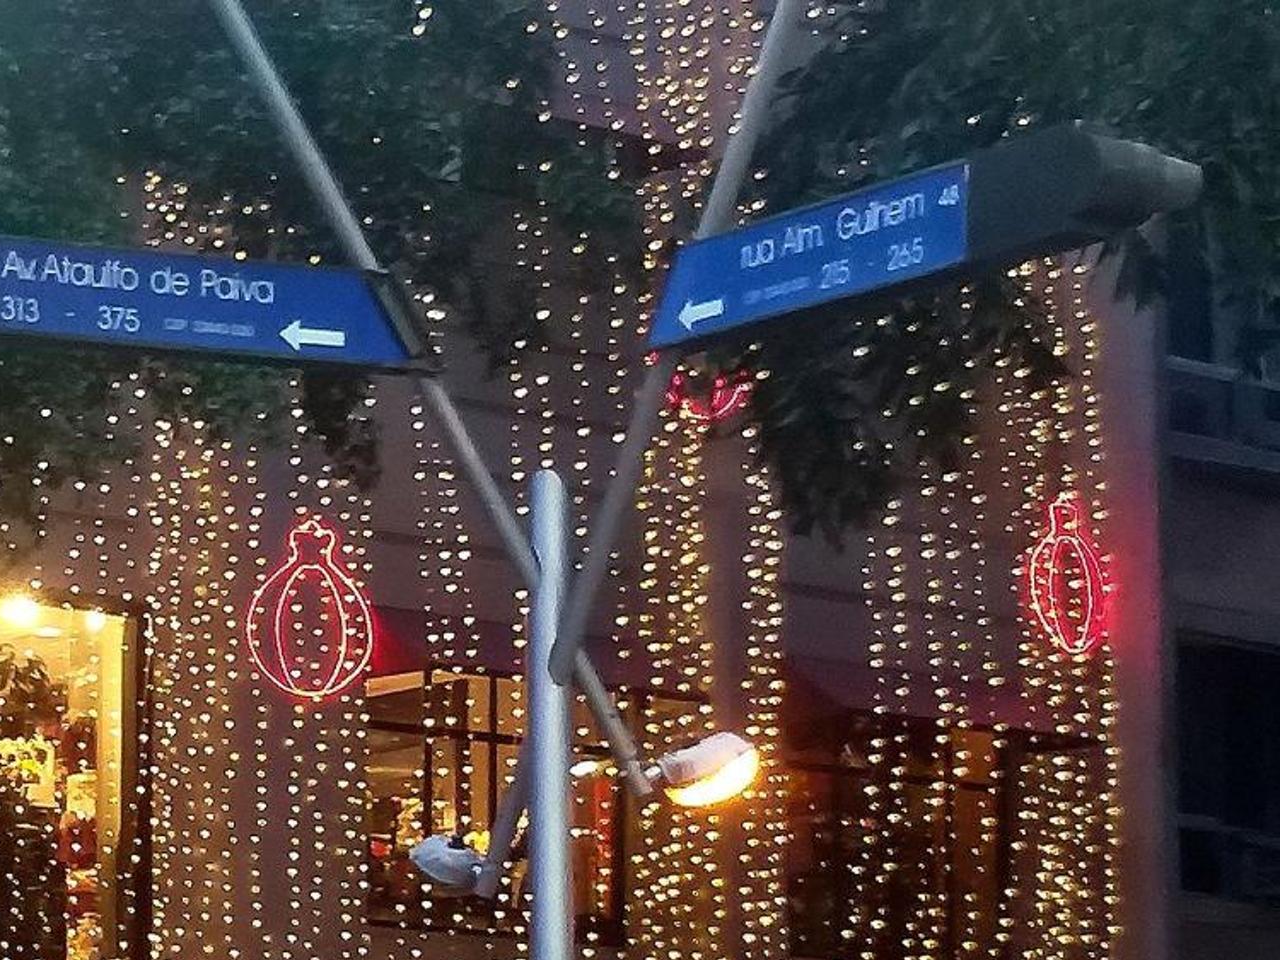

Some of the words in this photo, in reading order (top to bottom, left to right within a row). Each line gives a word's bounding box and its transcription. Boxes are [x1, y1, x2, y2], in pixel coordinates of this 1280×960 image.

[40, 253, 140, 291] Ataulfo
[150, 266, 191, 296] de
[200, 268, 275, 304] Paiva
[0, 295, 40, 323] 313
[97, 305, 141, 332] 375
